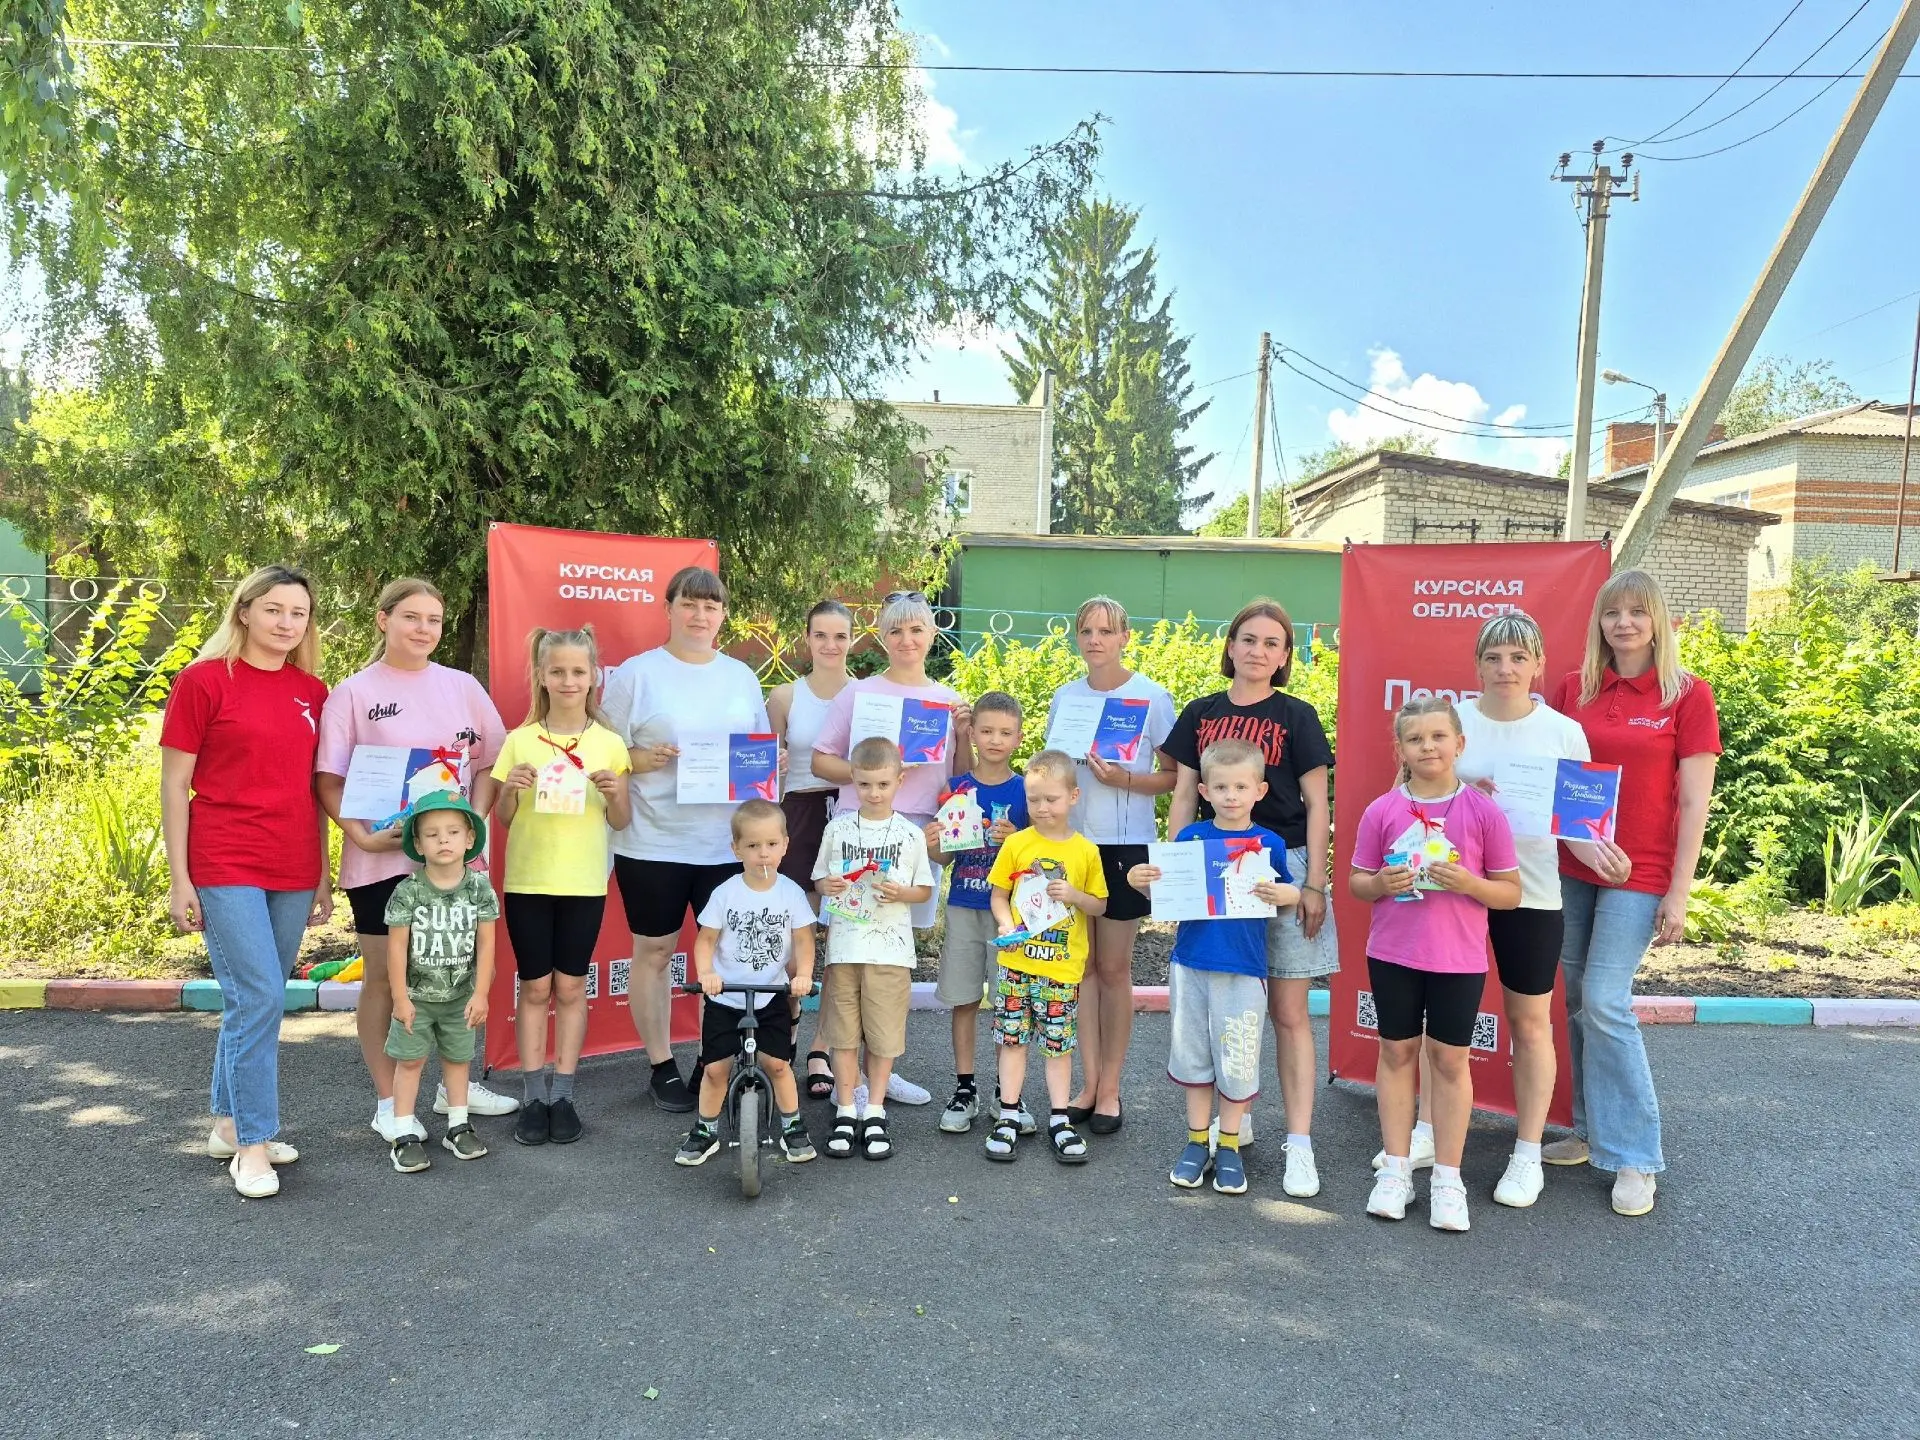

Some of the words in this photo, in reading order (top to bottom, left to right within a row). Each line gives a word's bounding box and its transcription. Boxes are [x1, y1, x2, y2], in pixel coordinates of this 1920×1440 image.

[559, 562, 654, 582] КУРСКАЯ
[559, 584, 655, 603] ОБЛАСТЬ
[1413, 579, 1524, 596] КУРСКАЯ
[1412, 602, 1524, 619] ОБЛАСТЬ
[368, 702, 403, 722] chill
[413, 905, 478, 931] SURF
[412, 931, 476, 957] DAYS
[1024, 943, 1055, 961] ON!
[1224, 1016, 1245, 1080] ROAD
[1242, 1010, 1258, 1082] CROSS
